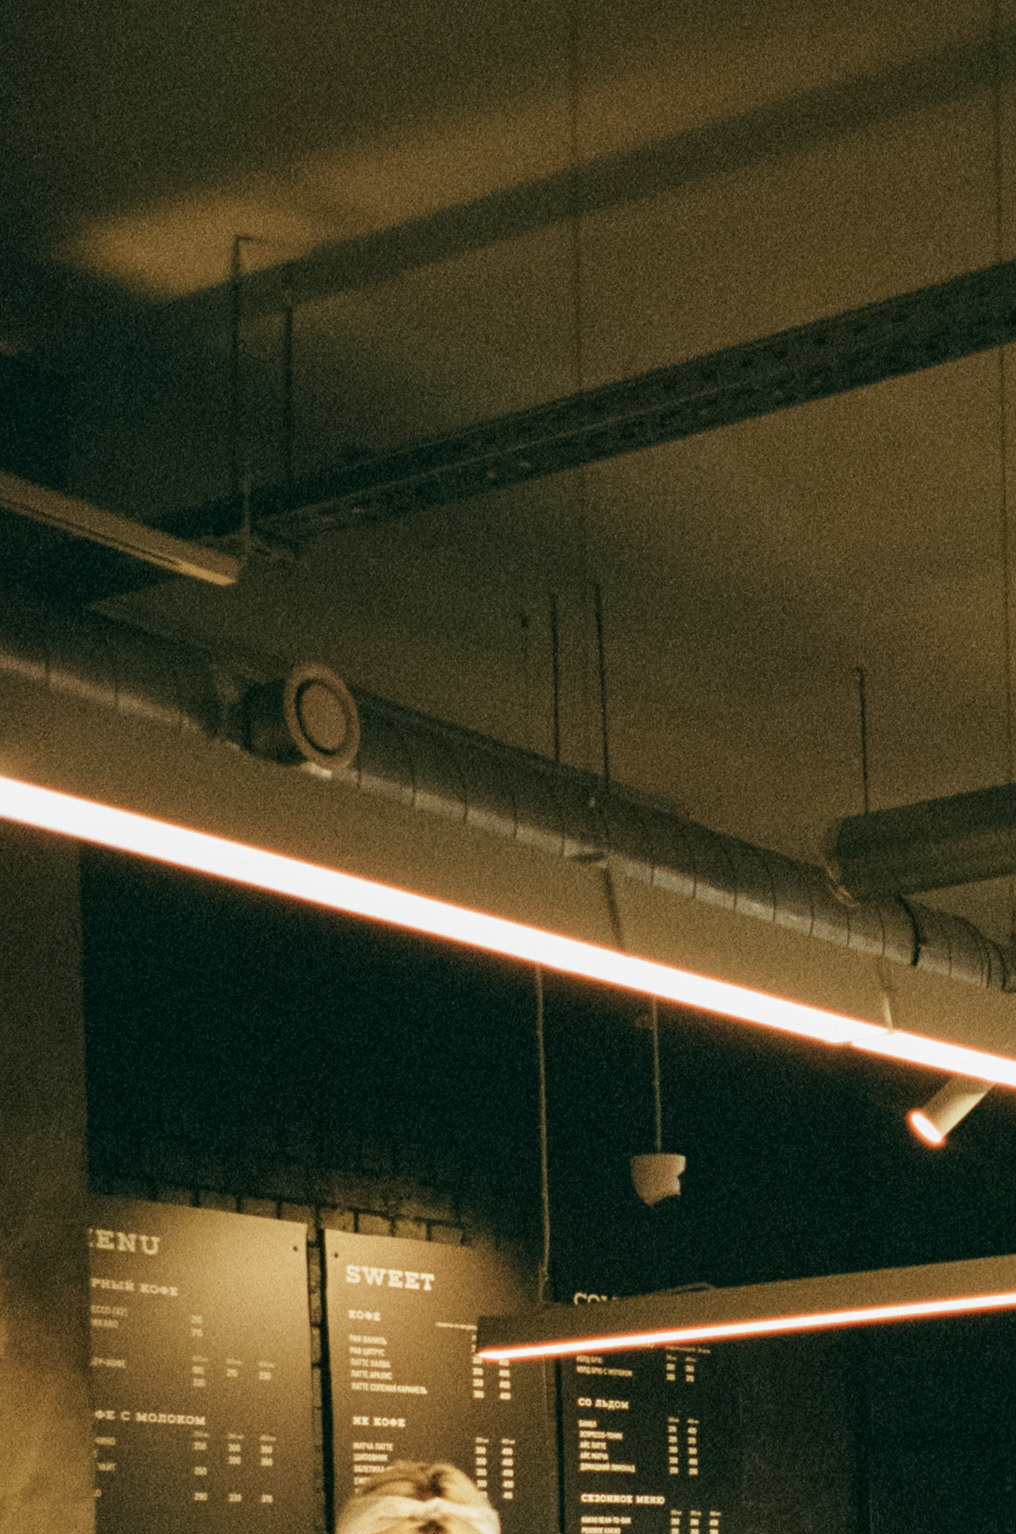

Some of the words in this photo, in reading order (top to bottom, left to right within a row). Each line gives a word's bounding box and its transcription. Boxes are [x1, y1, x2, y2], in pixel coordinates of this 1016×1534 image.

[88, 1228, 161, 1255] ENU
[346, 1264, 435, 1292] SWEET
[140, 1283, 179, 1297] КОФЕ
[348, 1309, 382, 1322] КОФЕ
[578, 1397, 592, 1406] СО
[595, 1398, 629, 1410] ЛЬДОМ
[120, 1411, 131, 1421] С
[136, 1412, 206, 1426] МОЛОКОМ
[352, 1416, 370, 1426] НЕ
[373, 1416, 406, 1428] КОФЕ
[581, 1493, 633, 1504] СЕЗОННОЕ
[636, 1495, 665, 1505] МЕНЮ
